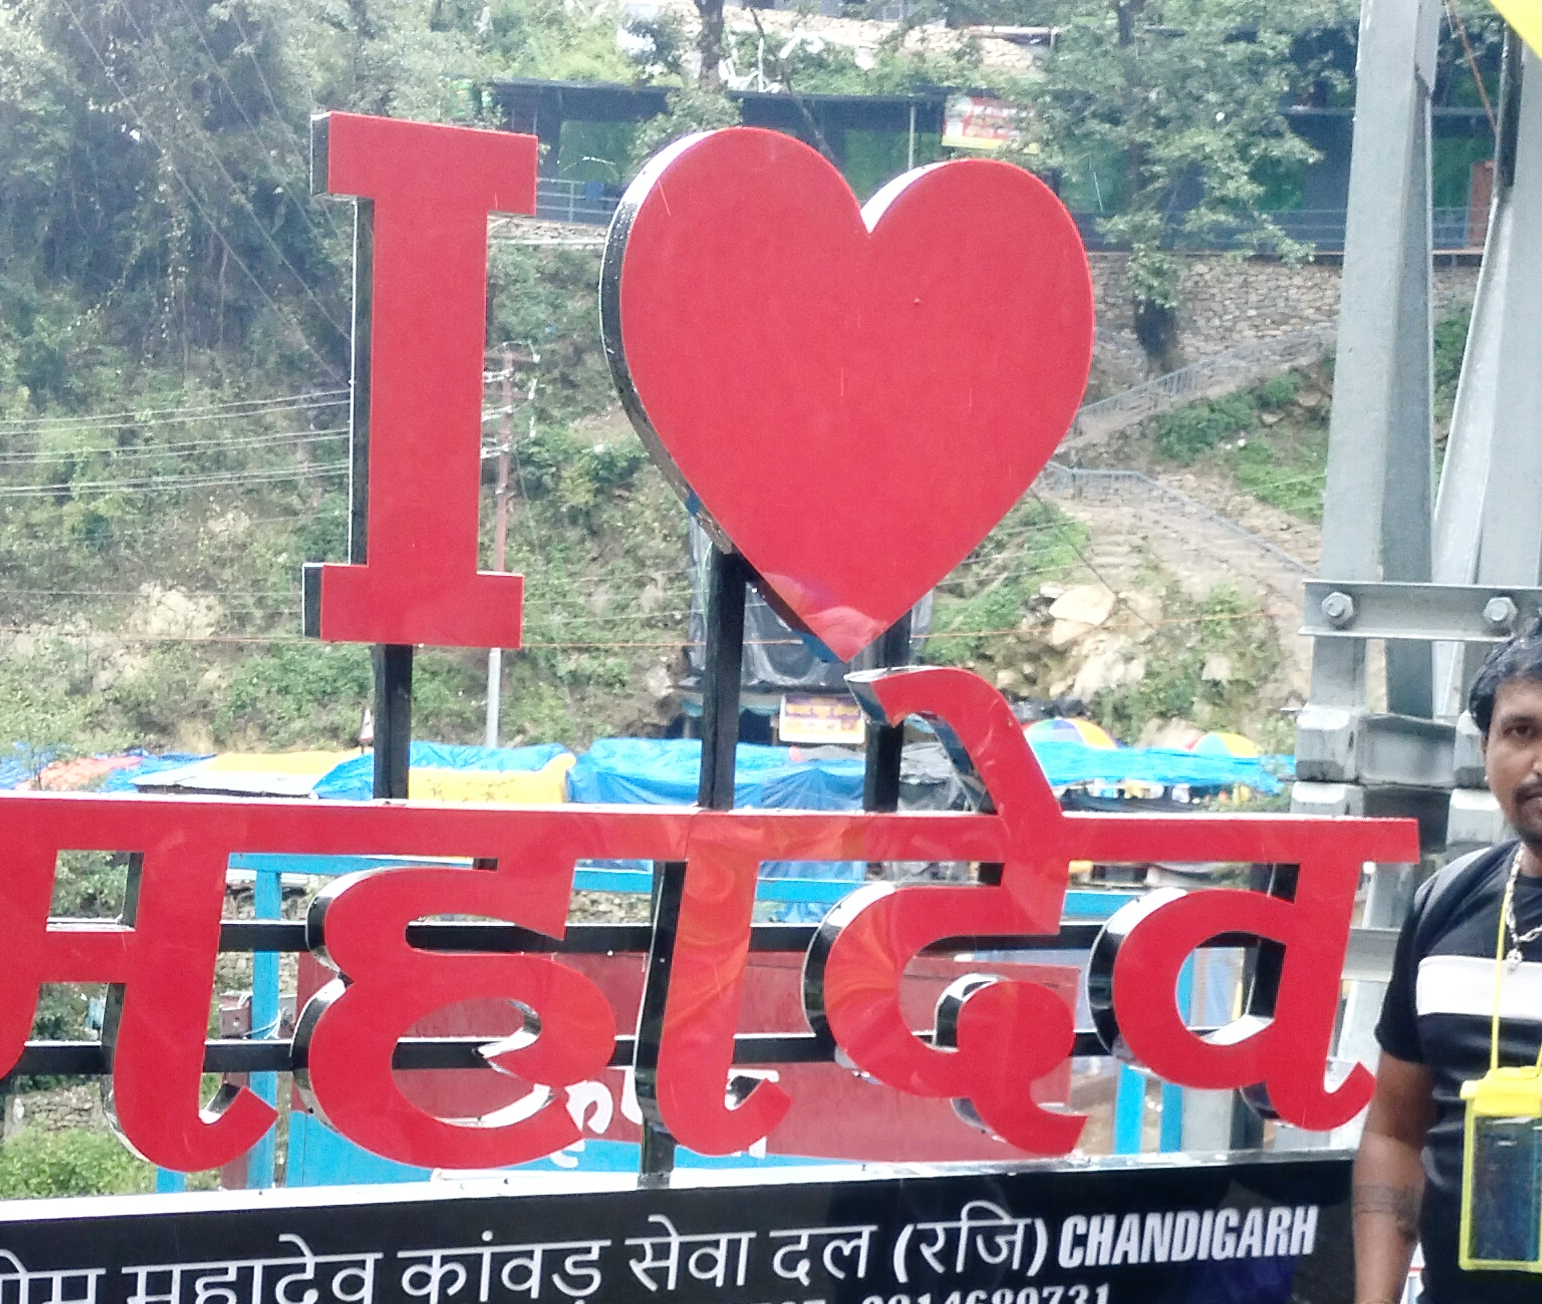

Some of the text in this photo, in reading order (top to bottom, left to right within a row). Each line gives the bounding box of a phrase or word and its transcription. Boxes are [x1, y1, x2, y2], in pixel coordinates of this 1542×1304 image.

[305, 111, 539, 649] I
[624, 1213, 758, 1293] सेवा
[768, 1224, 879, 1287] दल
[892, 1199, 1050, 1283] (रजि)
[1058, 1205, 1319, 1269] CHANDIGARH
